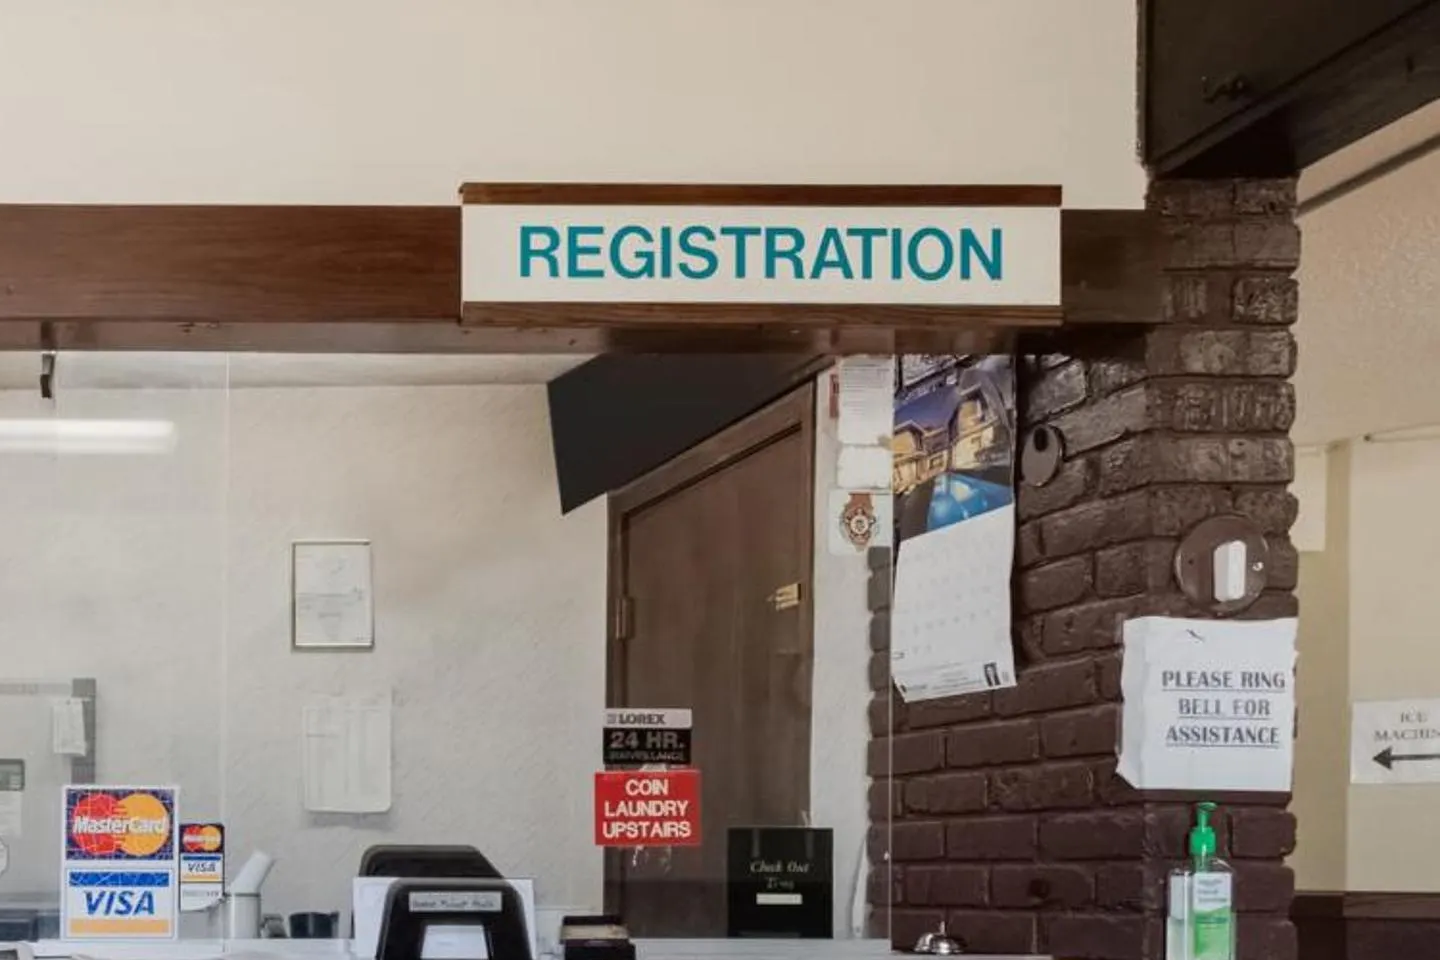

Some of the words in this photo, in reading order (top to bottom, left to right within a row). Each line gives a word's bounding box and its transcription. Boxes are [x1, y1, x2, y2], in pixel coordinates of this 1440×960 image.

[518, 225, 1003, 281] REGISTRATION
[1161, 670, 1234, 688] PLEASE
[1240, 671, 1286, 689] RING
[1178, 698, 1222, 715] BELL
[1233, 699, 1272, 716] FOR
[619, 713, 666, 725] LOREX
[1400, 710, 1429, 724] ICE
[610, 731, 639, 749] 24
[646, 731, 685, 749] HR.
[1165, 725, 1280, 744] ASSISTANCE
[625, 778, 669, 796] COIN
[603, 799, 689, 818] LAUNDRY
[73, 815, 166, 834] MasterCard
[602, 820, 692, 838] UPSTAIRS
[188, 862, 216, 873] VISA
[83, 889, 156, 916] VISA
